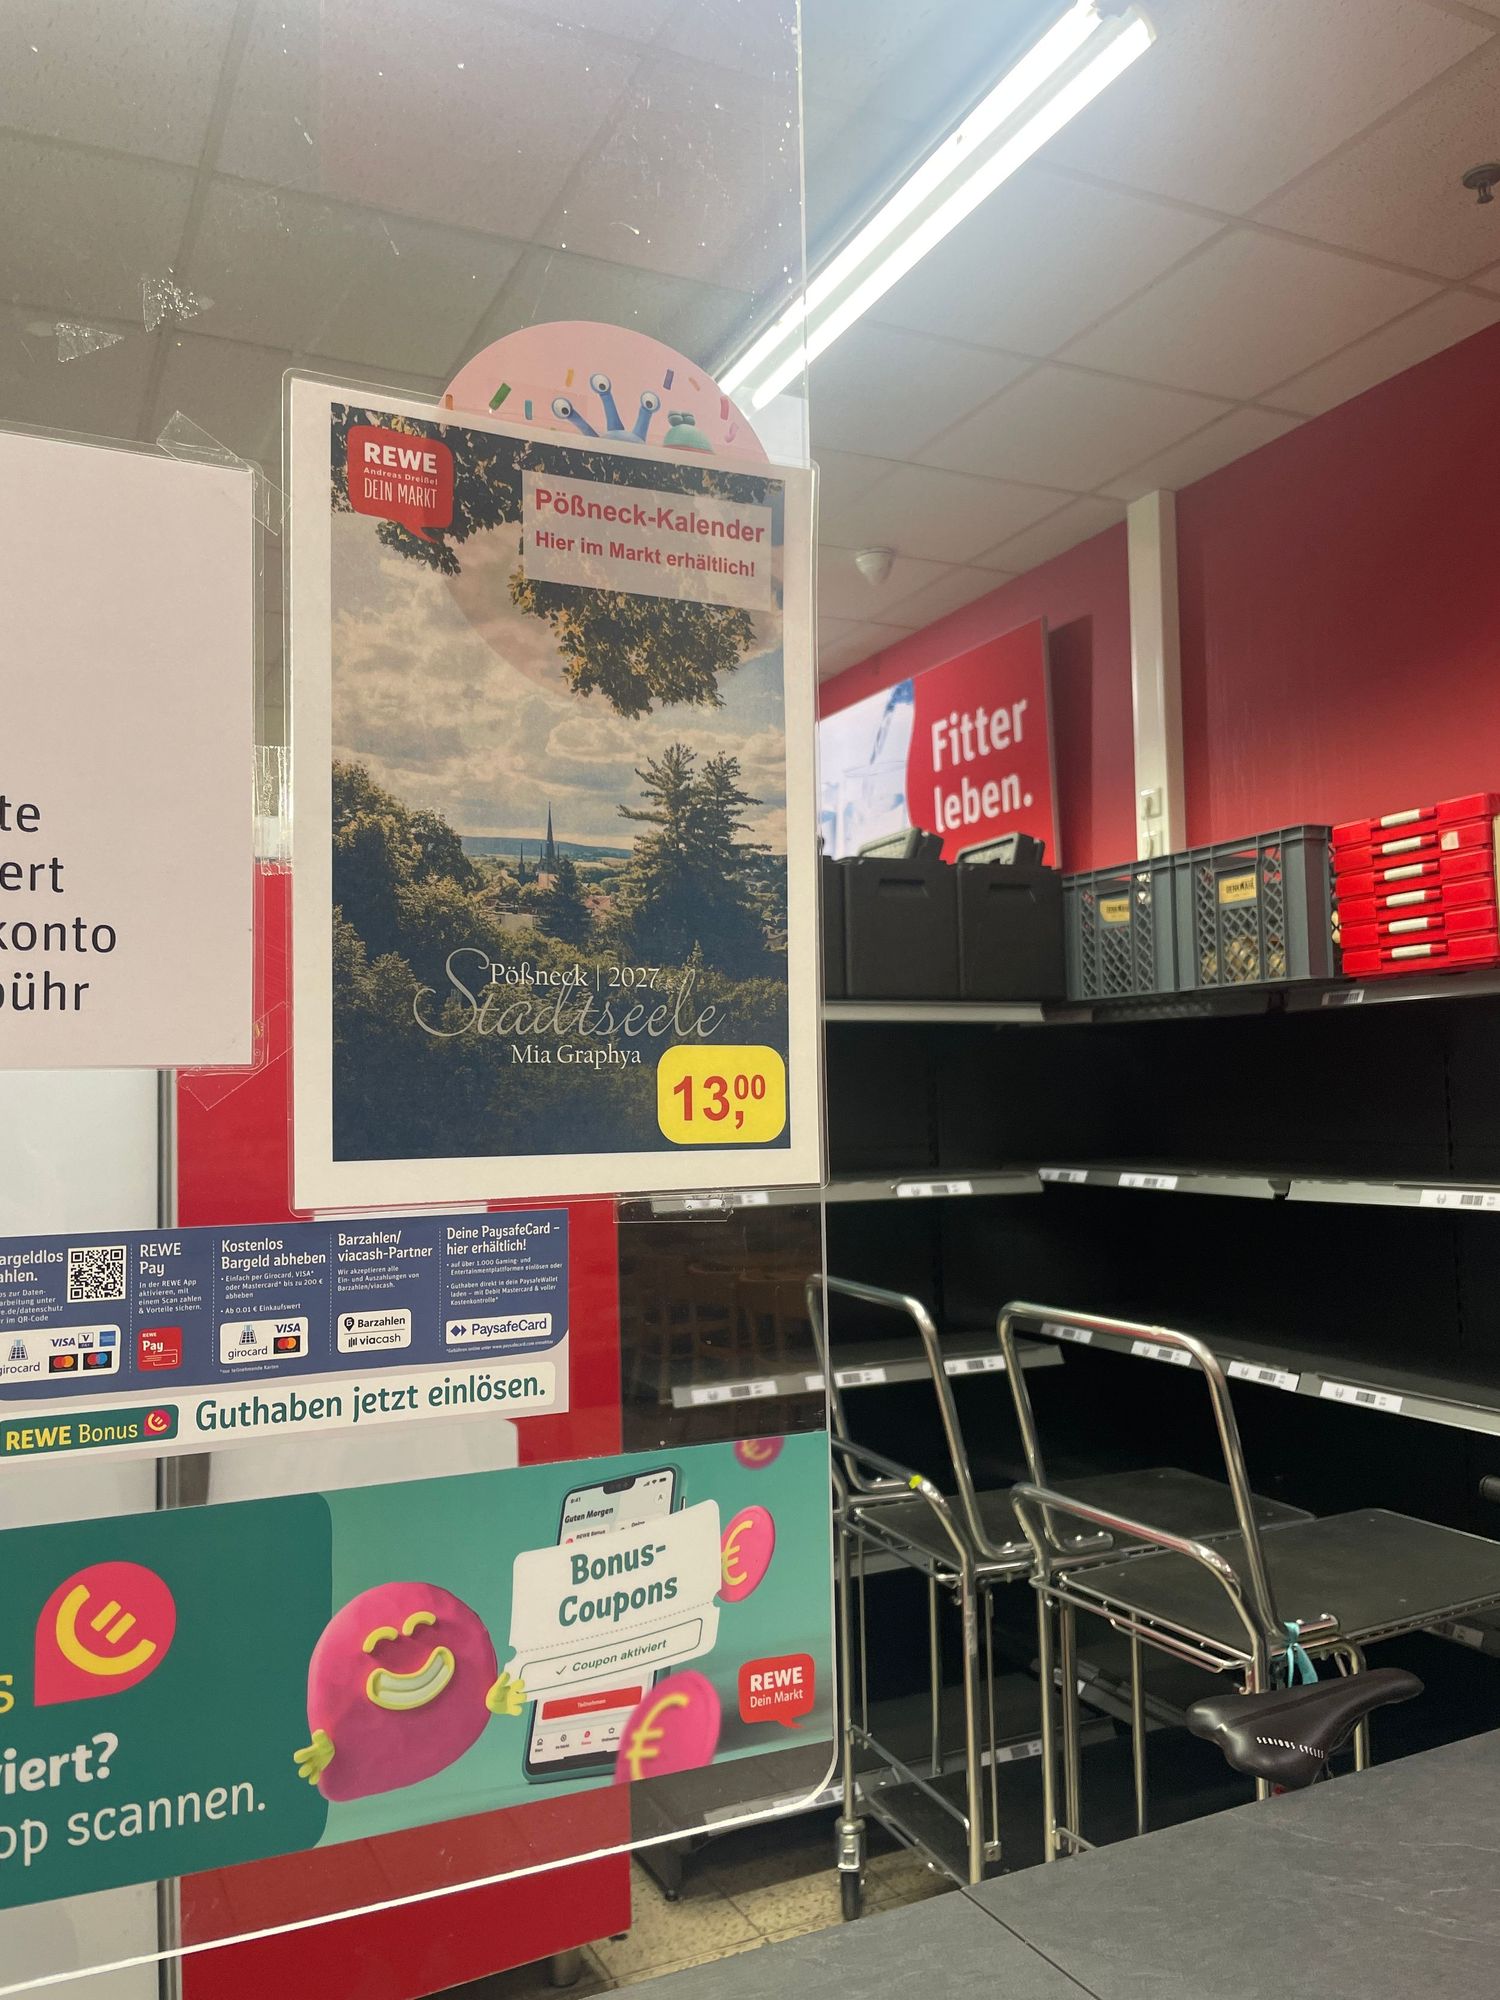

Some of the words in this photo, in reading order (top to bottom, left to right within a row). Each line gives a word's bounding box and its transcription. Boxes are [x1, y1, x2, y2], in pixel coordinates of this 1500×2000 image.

[364, 441, 438, 475] REWE
[363, 466, 402, 480] Andreas
[364, 477, 393, 502] DEIN
[398, 482, 438, 509] MARKT
[535, 488, 765, 543] Pößneck-Kalender
[535, 530, 575, 551] Hier
[581, 536, 603, 556] im
[609, 541, 661, 565] Markt
[666, 552, 756, 577] erhältlich!
[931, 697, 1028, 773] Fitter
[933, 772, 1033, 834] leben.
[489, 962, 589, 987] Pößneck
[608, 967, 660, 989] 2027
[413, 947, 726, 1037] Stadtseele
[511, 1044, 551, 1065] Mia
[557, 1044, 641, 1070] Graphya
[338, 1230, 402, 1246] Barzahlen/
[447, 1227, 479, 1240] Deine
[481, 1222, 551, 1240] PaysafeCard
[140, 1242, 181, 1258] REWE
[222, 1237, 283, 1253] Kostenlos
[447, 1243, 468, 1255] hier
[471, 1238, 527, 1254] erhältlich!
[221, 1254, 270, 1272] Bargeld
[273, 1251, 326, 1267] abheben
[338, 1246, 433, 1262] viacash-Partner
[140, 1261, 165, 1277] Pay
[350, 1266, 386, 1275] akzeptieren
[450, 1265, 524, 1276] Entertainmentplattformen
[525, 1263, 549, 1271] einlösen
[162, 1279, 181, 1287] REWE
[183, 1279, 197, 1287] App
[225, 1273, 250, 1282] Einfach
[365, 1273, 407, 1282] Auszahlungen
[450, 1282, 478, 1290] Guthaben
[519, 1276, 558, 1285] PaysafeWallet
[138, 1289, 176, 1298] aktivieren,
[338, 1282, 395, 1292] Barzahlen/viacash.
[450, 1290, 467, 1298] laden
[501, 1286, 533, 1294] Mastercard
[138, 1298, 160, 1306] einem
[162, 1296, 178, 1304] Scan
[179, 1295, 202, 1303] zahlen
[225, 1292, 254, 1300] abheben
[138, 1306, 144, 1314] &
[146, 1305, 173, 1313] Vorteile
[175, 1304, 202, 1312] sichern.
[259, 1303, 301, 1312] Einkaufswert
[17, 1314, 48, 1324] QR-Code
[357, 1316, 406, 1328] Barzahlen
[274, 1323, 301, 1333] VISA
[471, 1318, 547, 1337] PaysafeCard
[51, 1337, 76, 1347] VISA
[142, 1340, 164, 1352] Pay
[360, 1333, 401, 1345] viacash
[228, 1346, 268, 1360] girocard
[195, 1393, 342, 1431] Guthaben
[352, 1385, 419, 1423] jetzt
[428, 1374, 546, 1407] einlösen.
[6, 1425, 71, 1451] REWE
[78, 1422, 138, 1444] Bonus
[564, 1512, 586, 1524] Guten
[586, 1507, 614, 1520] Morgen
[570, 1544, 666, 1585] Bonus-
[558, 1577, 678, 1627] Coupons
[572, 1652, 617, 1672] Coupon
[620, 1639, 667, 1661] aktiviert
[750, 1666, 803, 1693] REWE
[750, 1694, 772, 1708] Dein
[774, 1688, 804, 1704] Markt
[0, 1732, 119, 1795] iert?
[67, 1782, 266, 1846] scannen.
